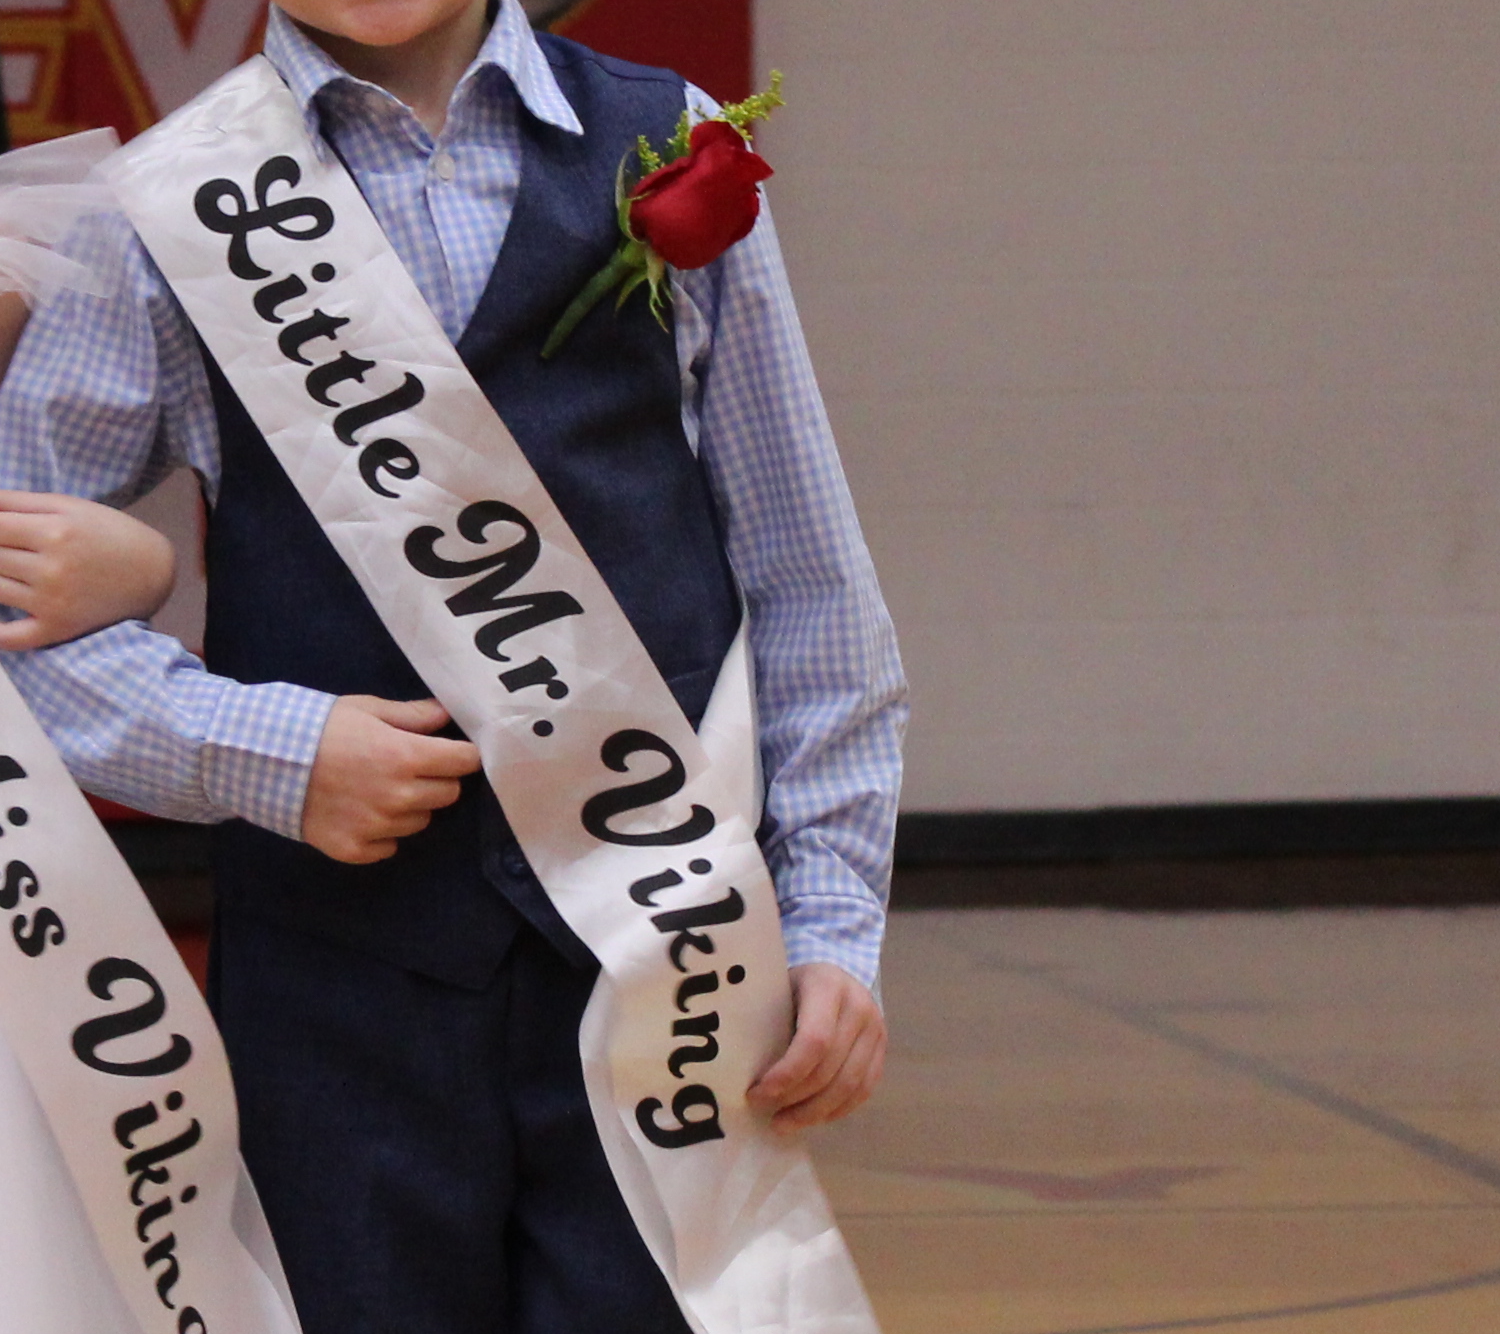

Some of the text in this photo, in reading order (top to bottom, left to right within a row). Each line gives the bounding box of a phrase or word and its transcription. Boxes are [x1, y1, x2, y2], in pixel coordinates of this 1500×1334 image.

[194, 155, 747, 1151] Little Mr. Viking
